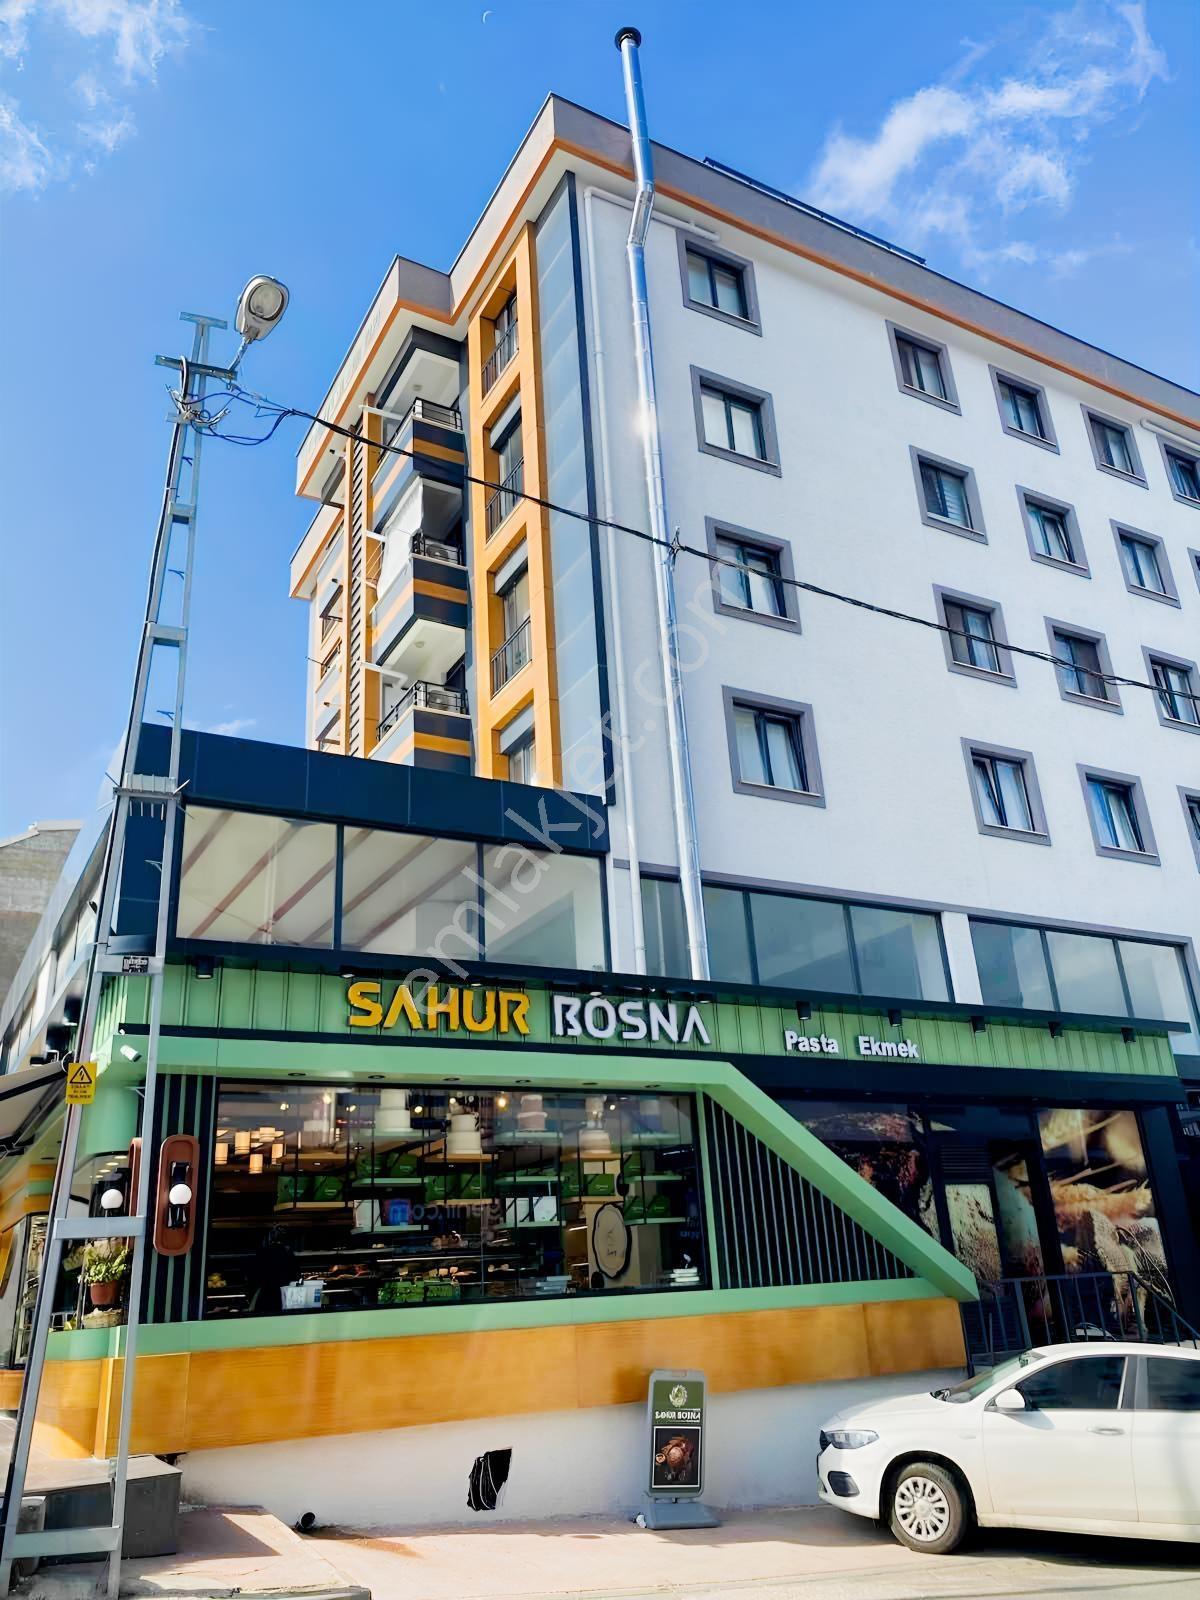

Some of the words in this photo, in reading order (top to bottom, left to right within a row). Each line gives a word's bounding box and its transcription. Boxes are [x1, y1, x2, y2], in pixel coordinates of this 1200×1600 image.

[347, 982, 531, 1035] SAHUR
[553, 994, 711, 1045] BOSNA
[784, 1030, 839, 1054] Pasta
[858, 1035, 919, 1058] Ekmek
